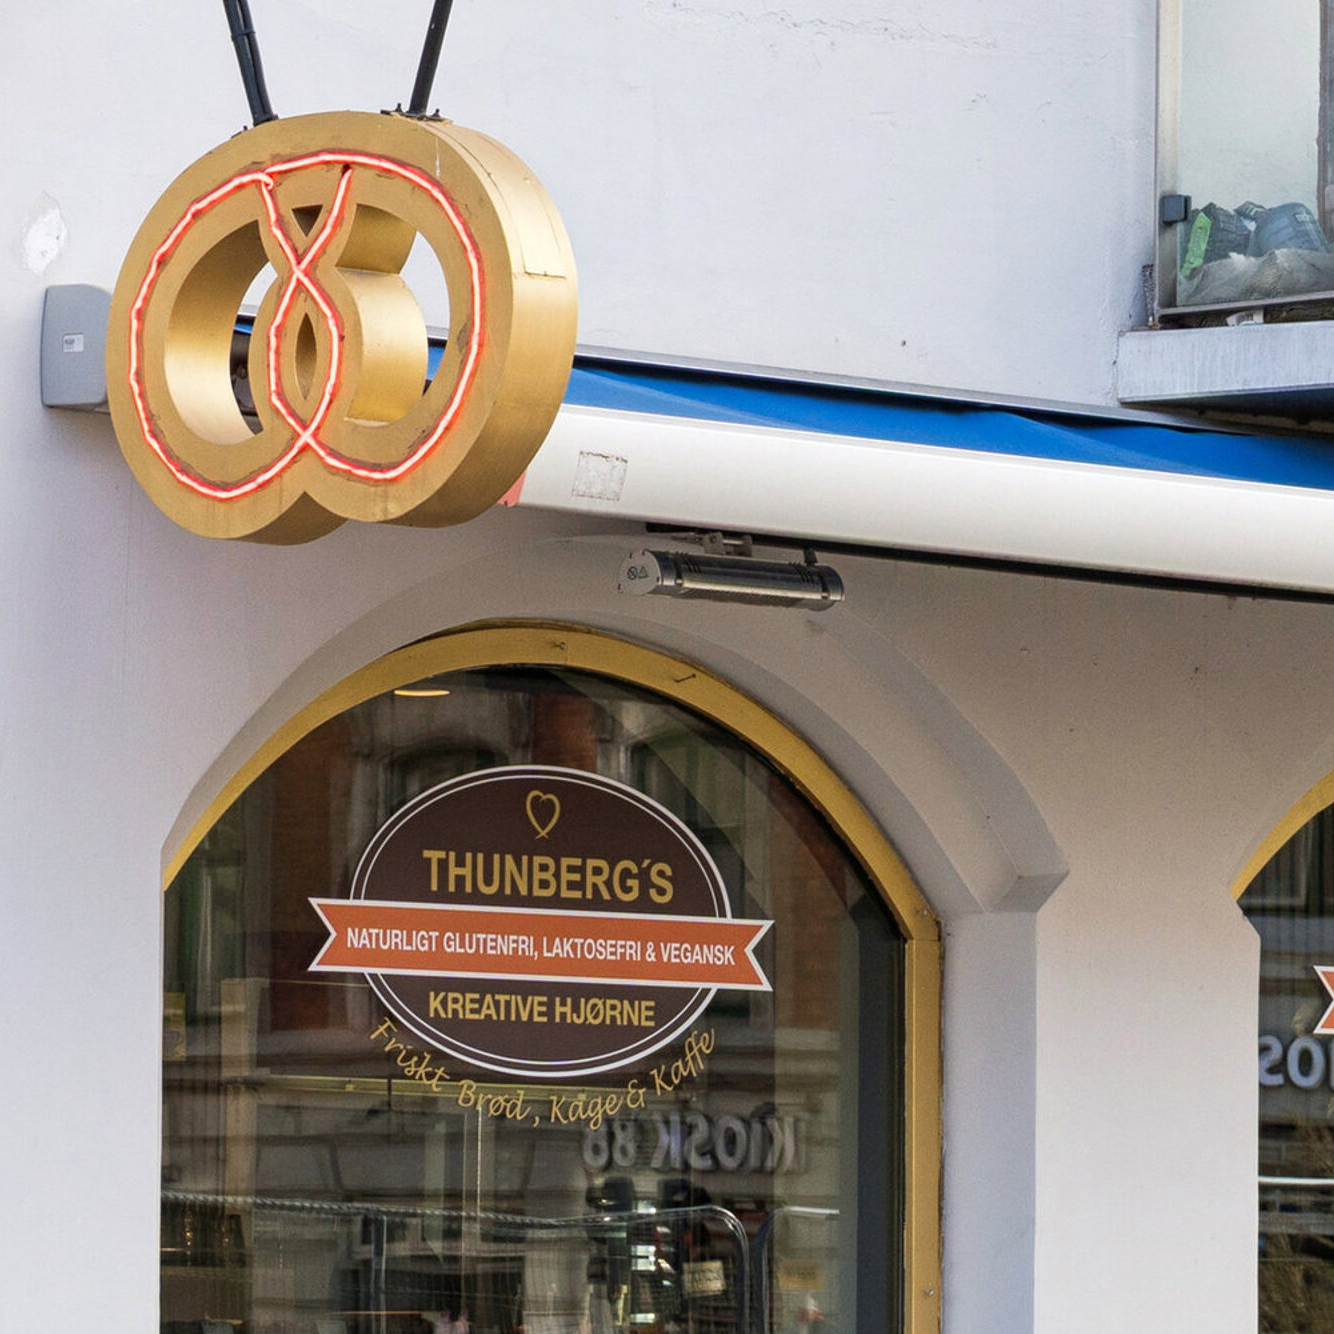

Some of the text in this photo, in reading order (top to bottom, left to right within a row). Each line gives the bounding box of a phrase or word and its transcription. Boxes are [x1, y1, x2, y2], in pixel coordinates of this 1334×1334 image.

[347, 927, 735, 966] NATURLIGT GLUTENFRI, LAKTOSEFRI & VEGANSK
[429, 991, 656, 1027] KREATIVE HJØRNE
[370, 1017, 451, 1092] Friskt
[550, 1091, 623, 1130] Kage
[627, 1082, 646, 1109] &
[651, 1028, 715, 1096] Kaffe
